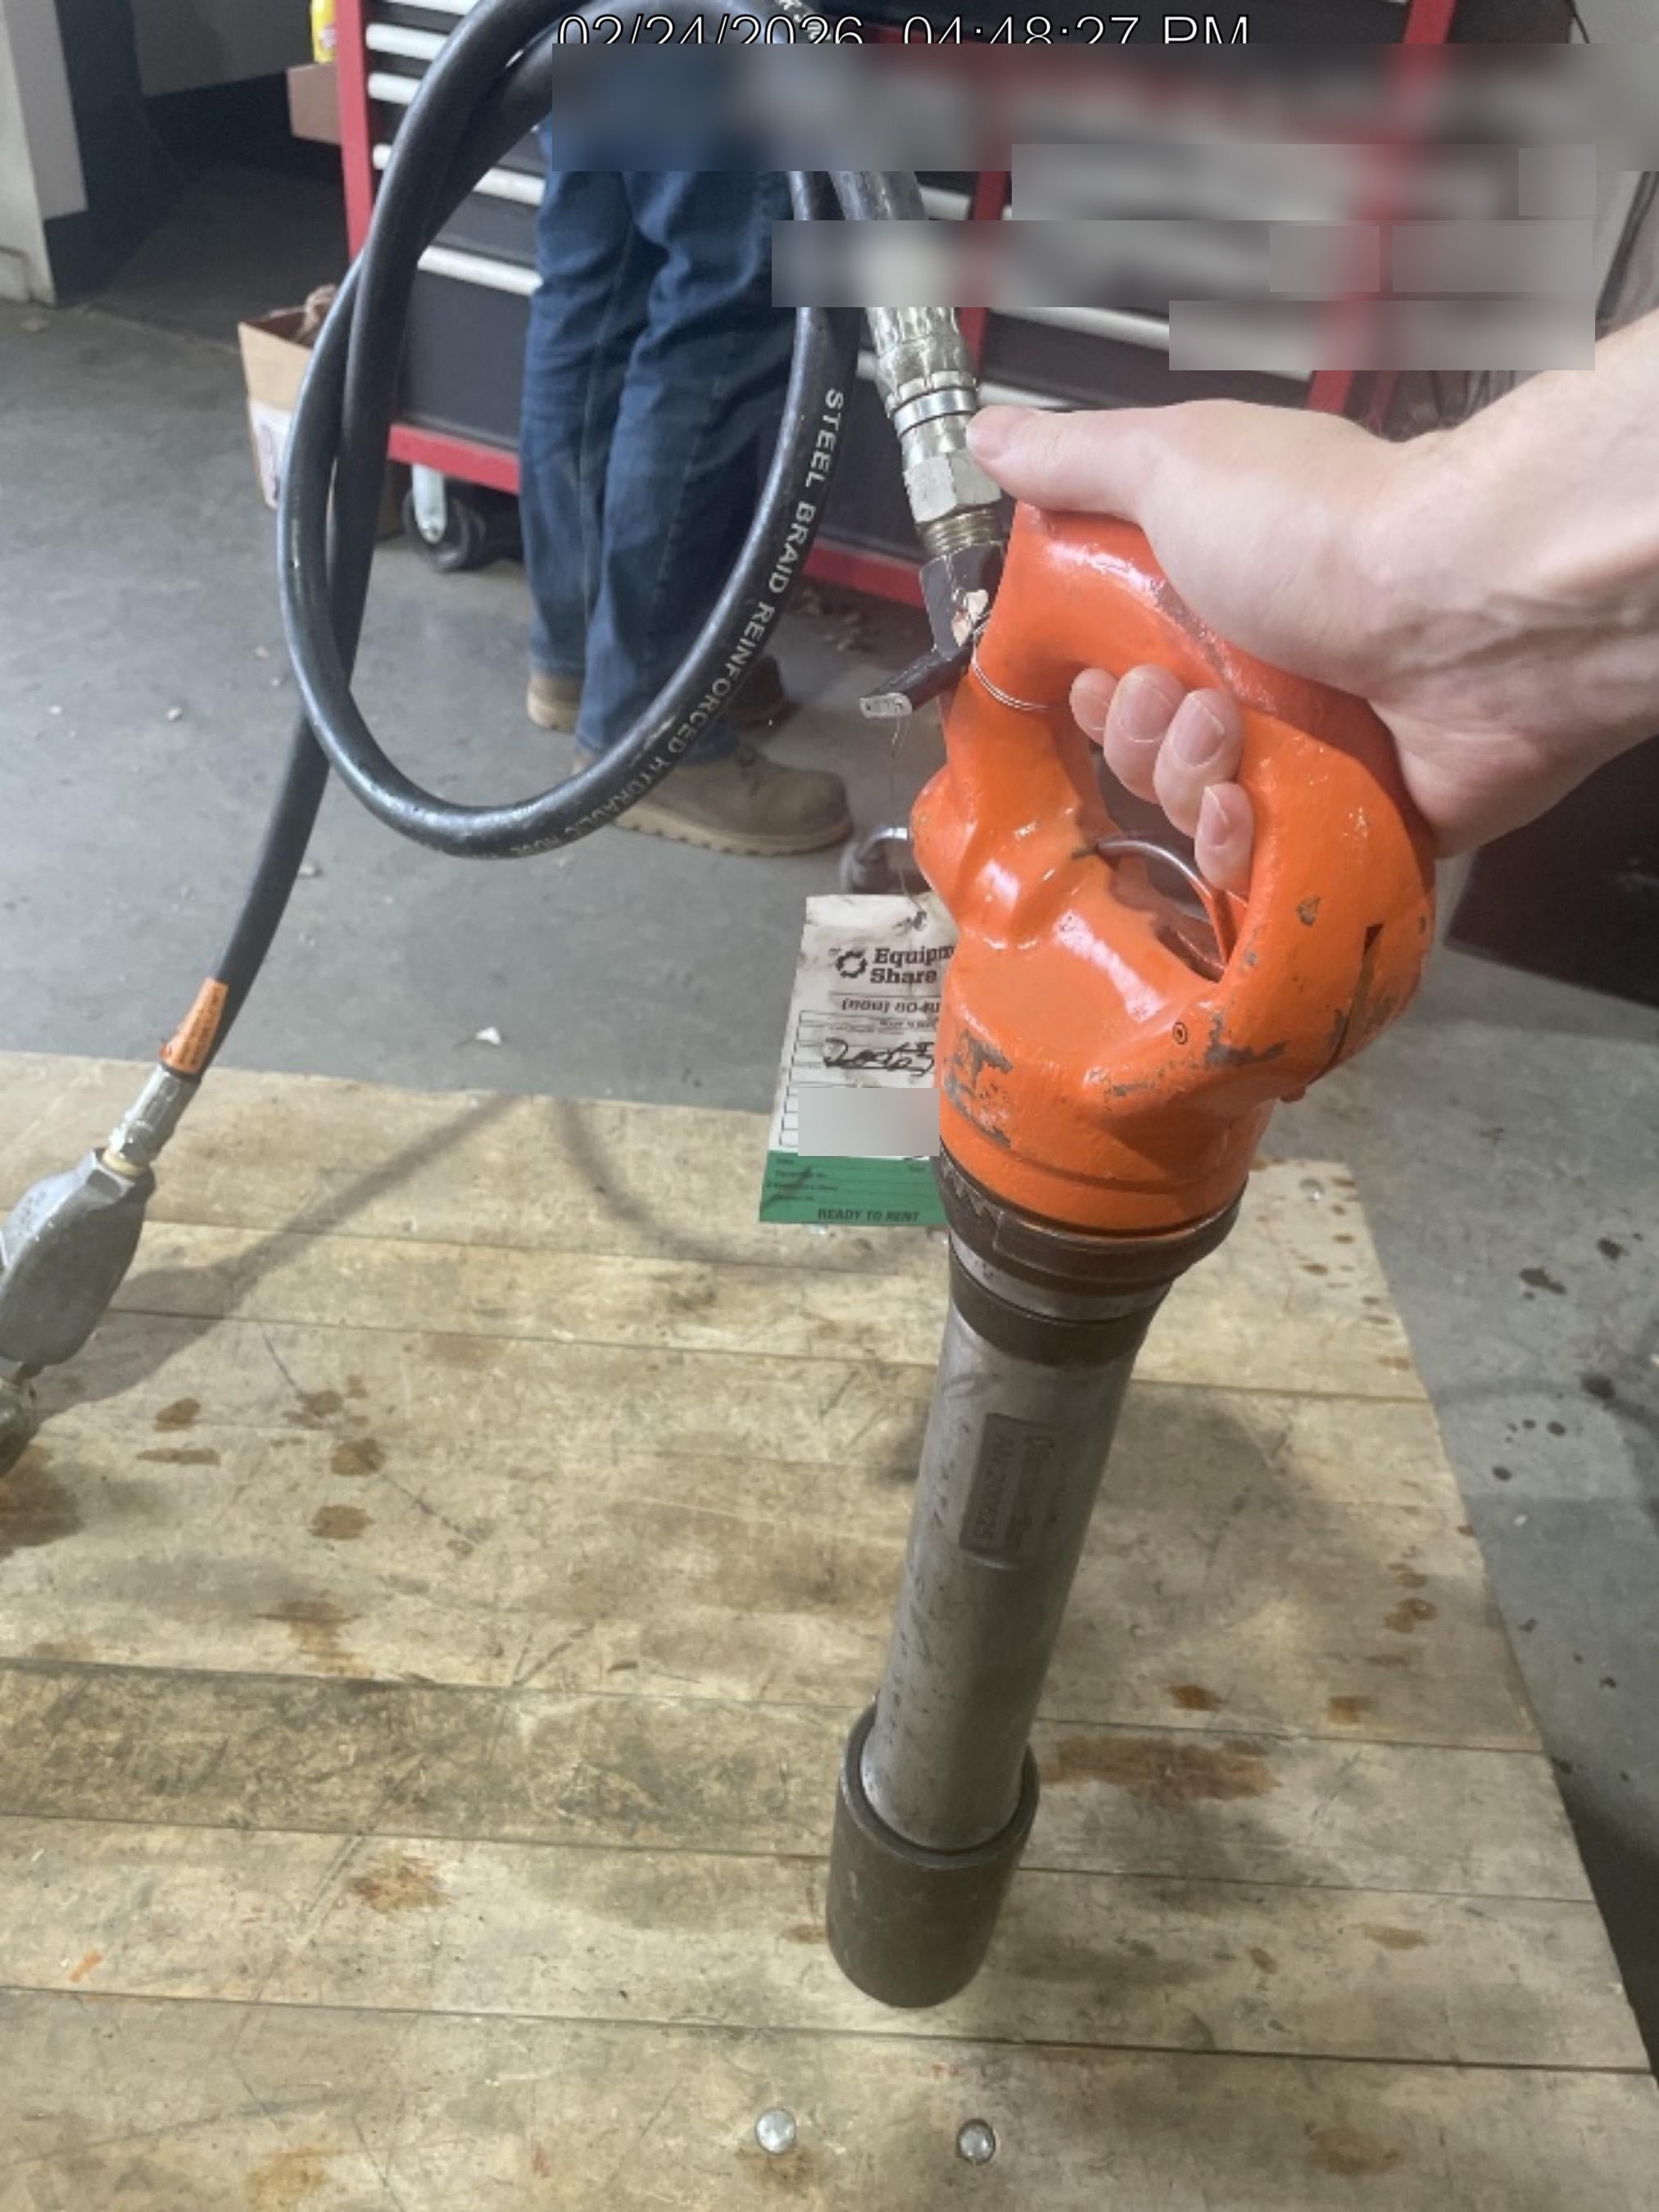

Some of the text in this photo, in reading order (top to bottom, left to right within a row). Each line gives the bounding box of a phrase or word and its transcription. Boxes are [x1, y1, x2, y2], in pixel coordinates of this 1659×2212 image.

[805, 388, 844, 488] STEEL
[768, 501, 817, 594] BRAID
[666, 601, 775, 755] REINFORCED
[869, 968, 938, 984] Share
[818, 1208, 921, 1222] READY TO RENT
